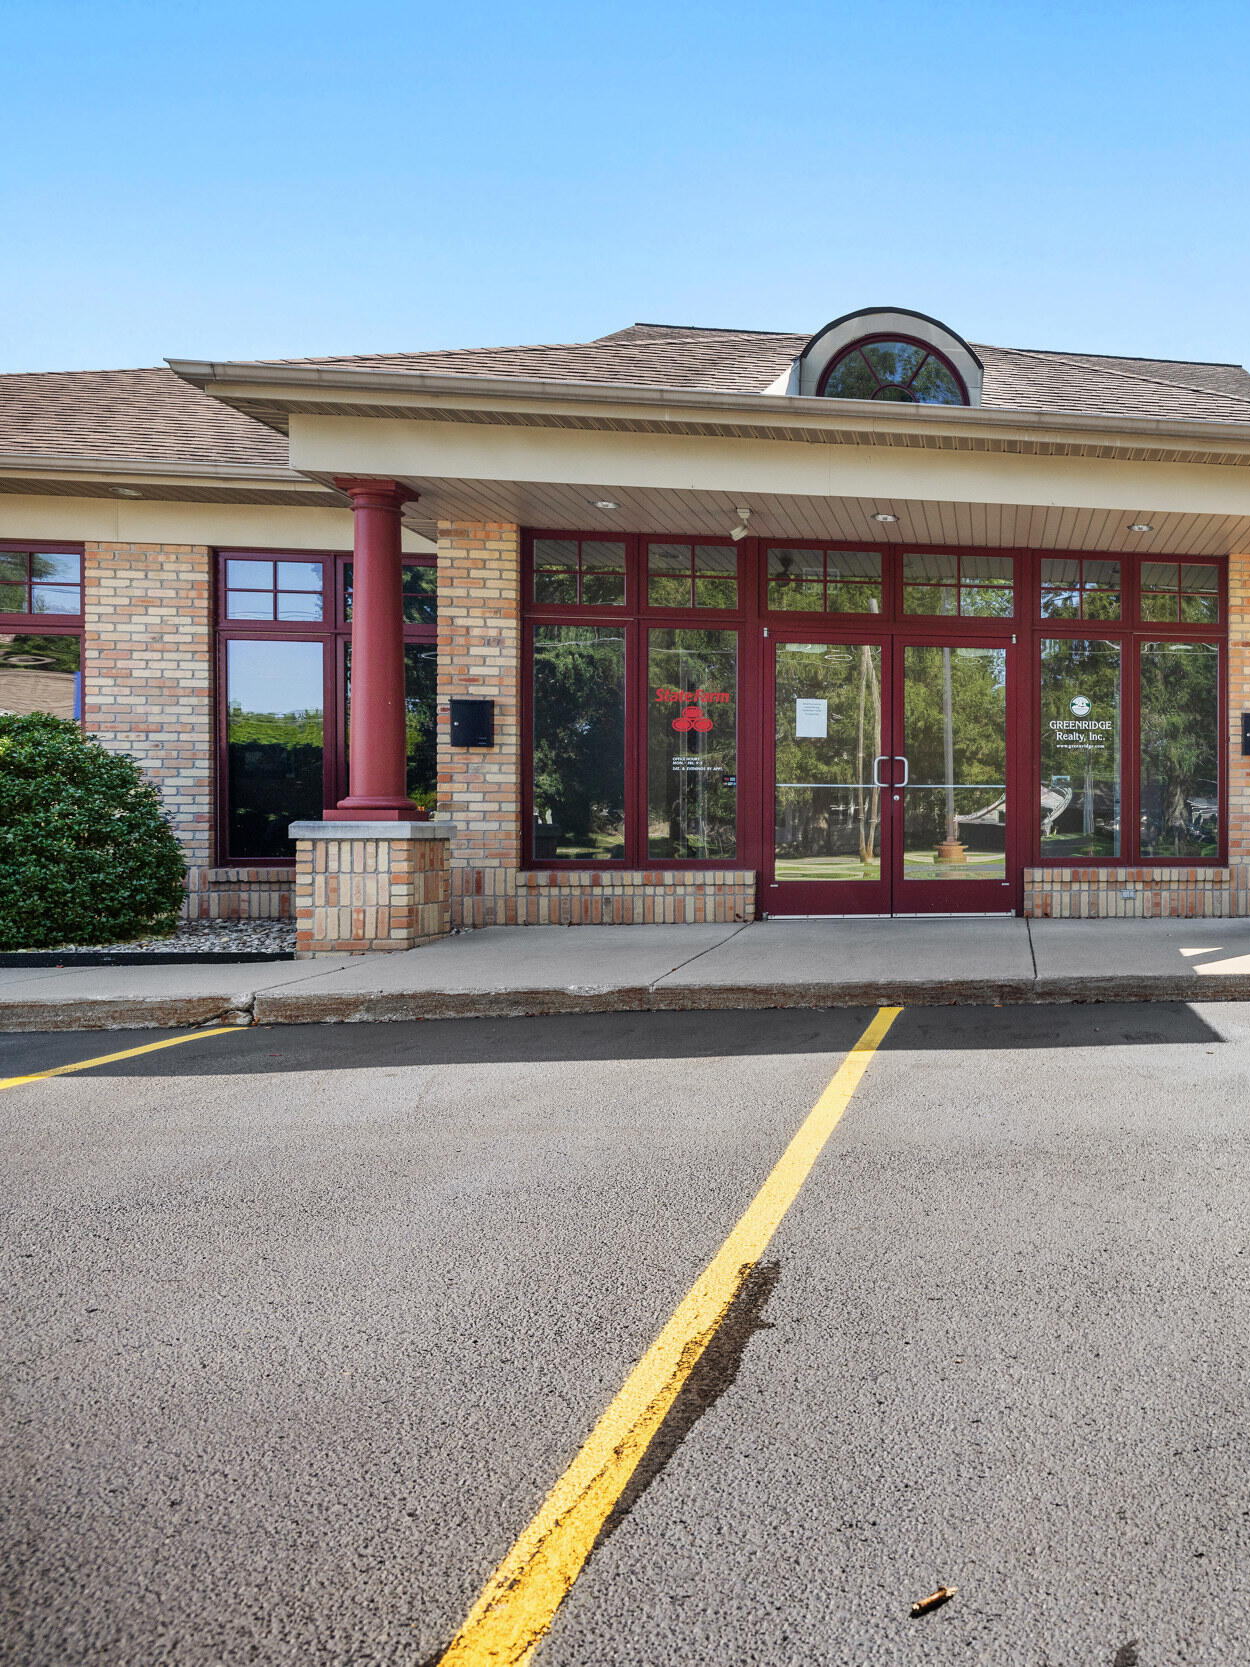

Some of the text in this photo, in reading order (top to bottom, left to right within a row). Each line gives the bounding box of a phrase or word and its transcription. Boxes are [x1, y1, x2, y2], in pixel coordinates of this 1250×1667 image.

[1049, 720, 1112, 730] GREENRIDGE
[1056, 731, 1105, 742] Realty, Inc.
